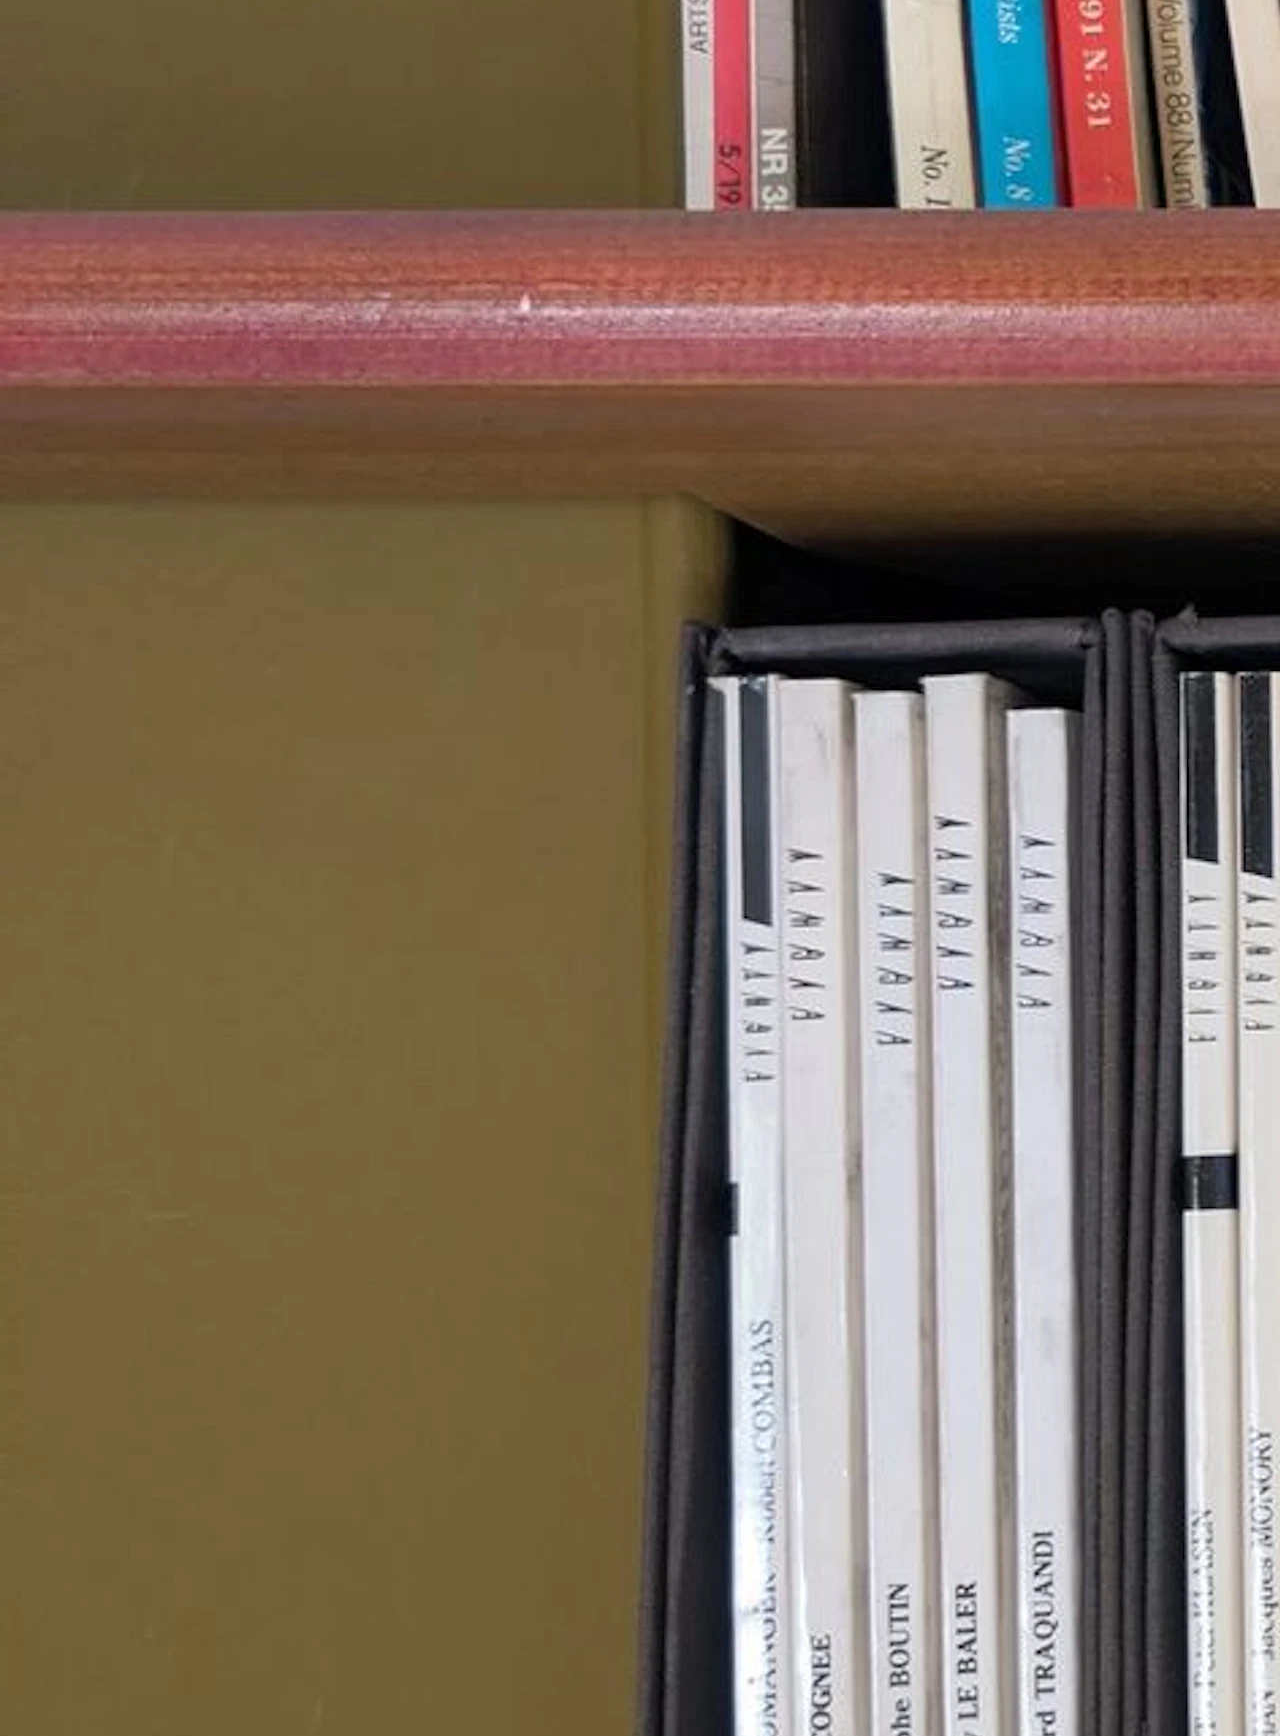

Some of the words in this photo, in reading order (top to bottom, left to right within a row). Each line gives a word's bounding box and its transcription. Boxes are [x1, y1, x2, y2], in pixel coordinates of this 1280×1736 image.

[1082, 48, 1108, 81] N.
[1086, 91, 1111, 128] 31
[887, 1582, 910, 1688] BOUTIN
[1032, 1530, 1059, 1699] TRAQUANDI
